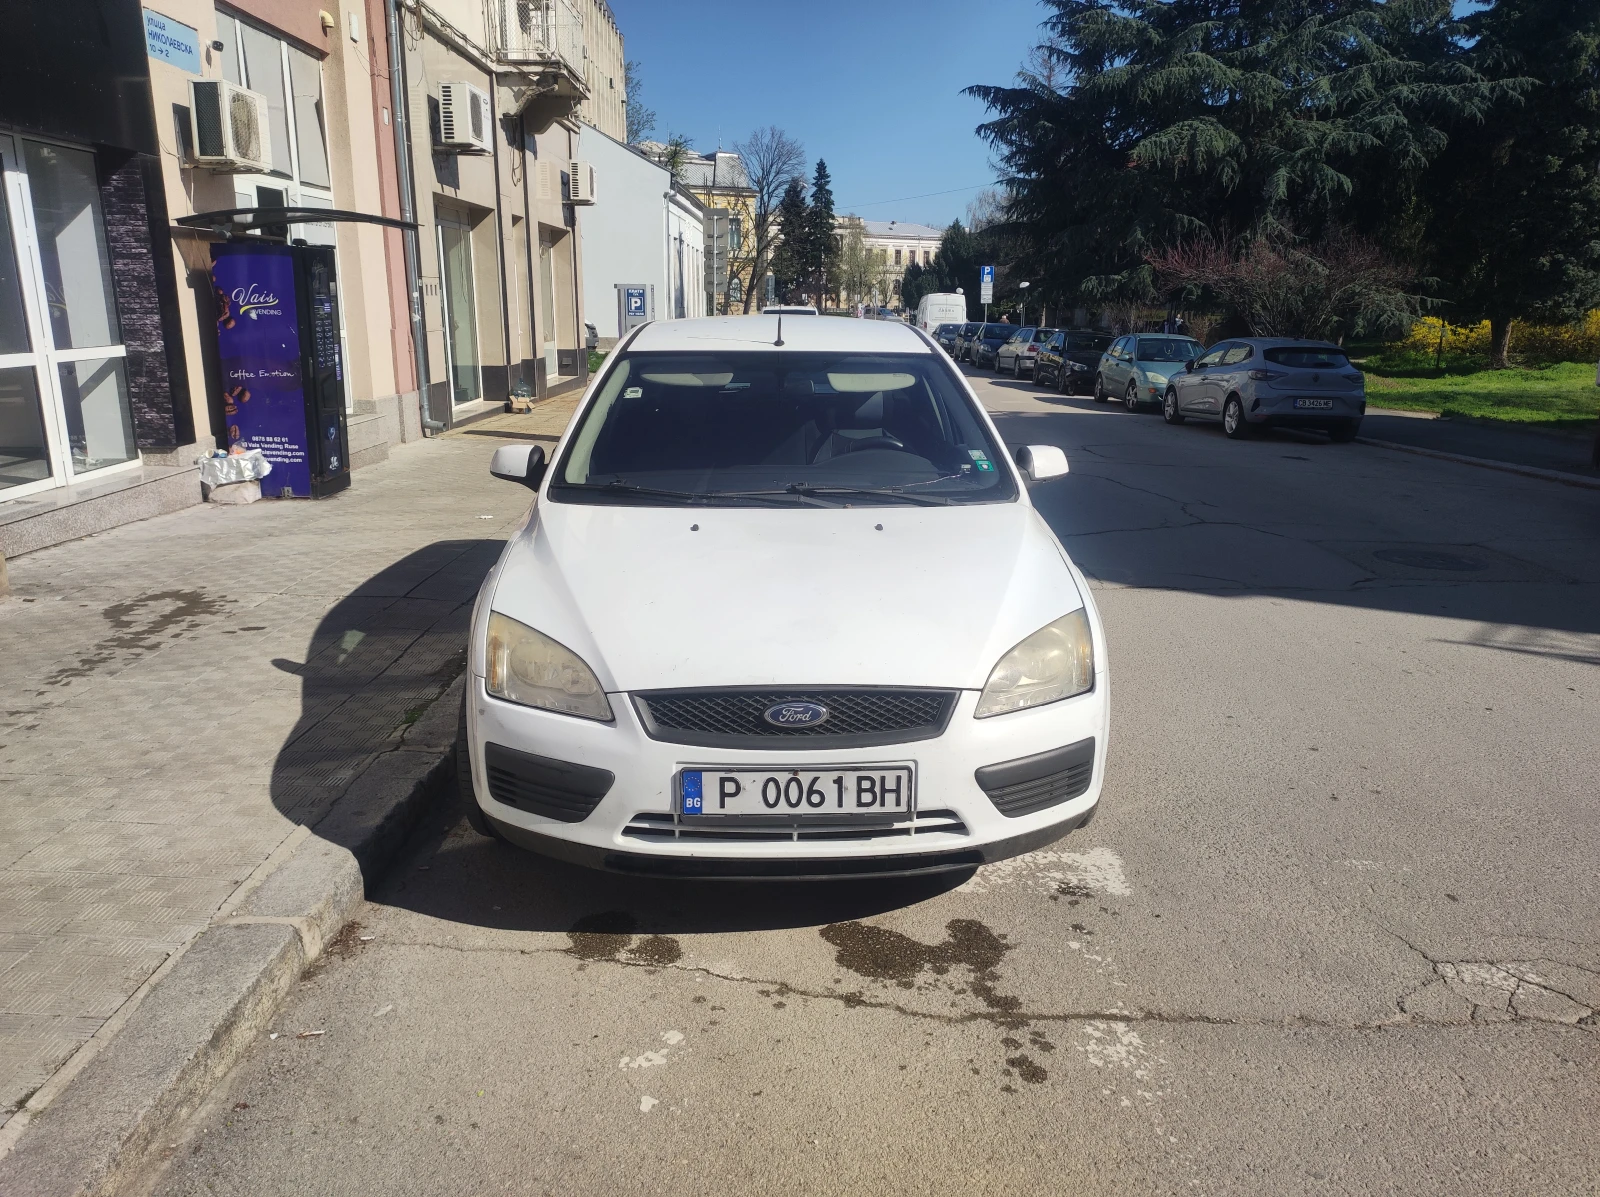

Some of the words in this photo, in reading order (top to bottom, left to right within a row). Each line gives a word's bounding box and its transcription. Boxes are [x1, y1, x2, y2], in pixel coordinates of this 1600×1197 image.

[148, 29, 194, 55] НИКОЛАЕВСКА
[984, 266, 991, 275] P
[232, 283, 276, 305] Vais
[631, 298, 641, 310] P
[230, 369, 256, 380] Coffee
[258, 369, 295, 378] Emotion
[779, 707, 811, 722] Ford
[685, 797, 701, 808] BG
[719, 776, 741, 808] P
